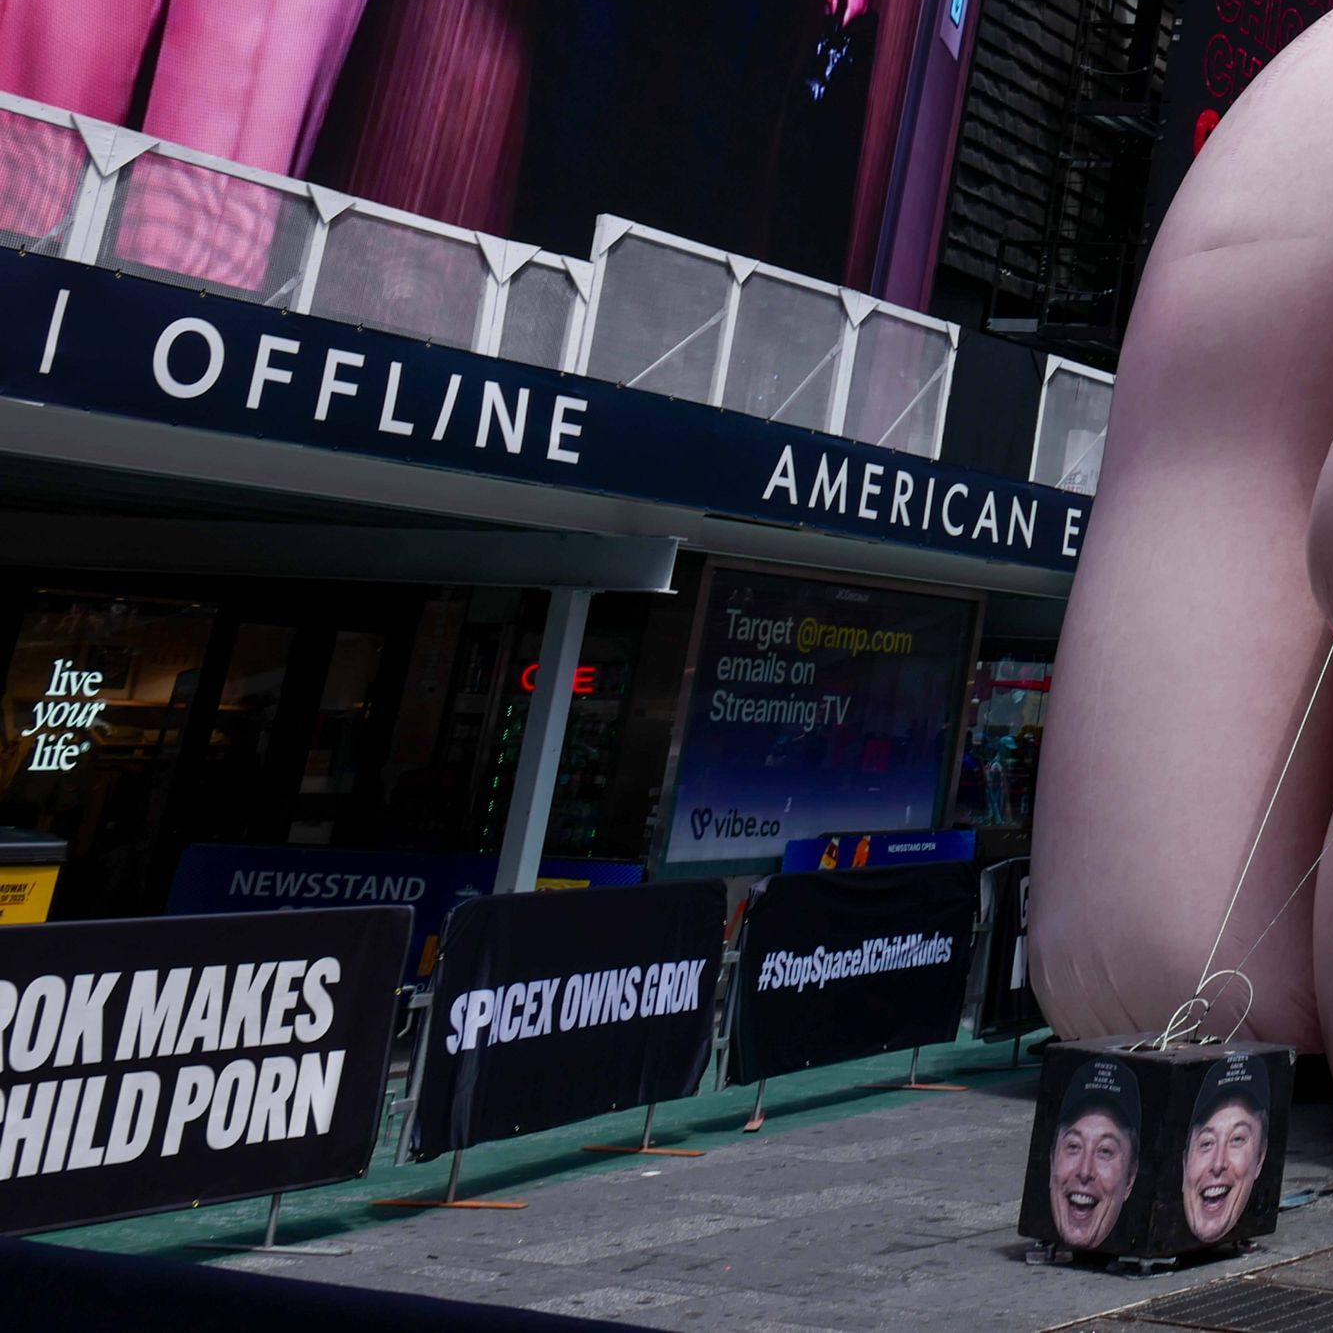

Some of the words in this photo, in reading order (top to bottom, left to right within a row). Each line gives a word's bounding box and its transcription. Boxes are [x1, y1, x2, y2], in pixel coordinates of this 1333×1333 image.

[761, 443, 1039, 550] AMERICAN
[726, 607, 794, 650] Target
[796, 617, 913, 657] @ramp.com
[45, 658, 104, 697] live
[716, 653, 786, 686] emails
[790, 660, 816, 686] on
[21, 700, 107, 737] your
[709, 689, 820, 733] Streaming
[820, 695, 852, 727] TV
[713, 813, 781, 840] vibe.co
[227, 868, 426, 904] NEWSSTAND
[757, 929, 953, 993] #StopSpaceXChildNudes
[114, 956, 342, 1062] MAKES
[446, 976, 561, 1056] SPACEX
[558, 966, 645, 1033] OWNS
[641, 958, 709, 1018] GROK
[0, 1070, 162, 1183] HILD
[161, 1049, 347, 1158] PORN
